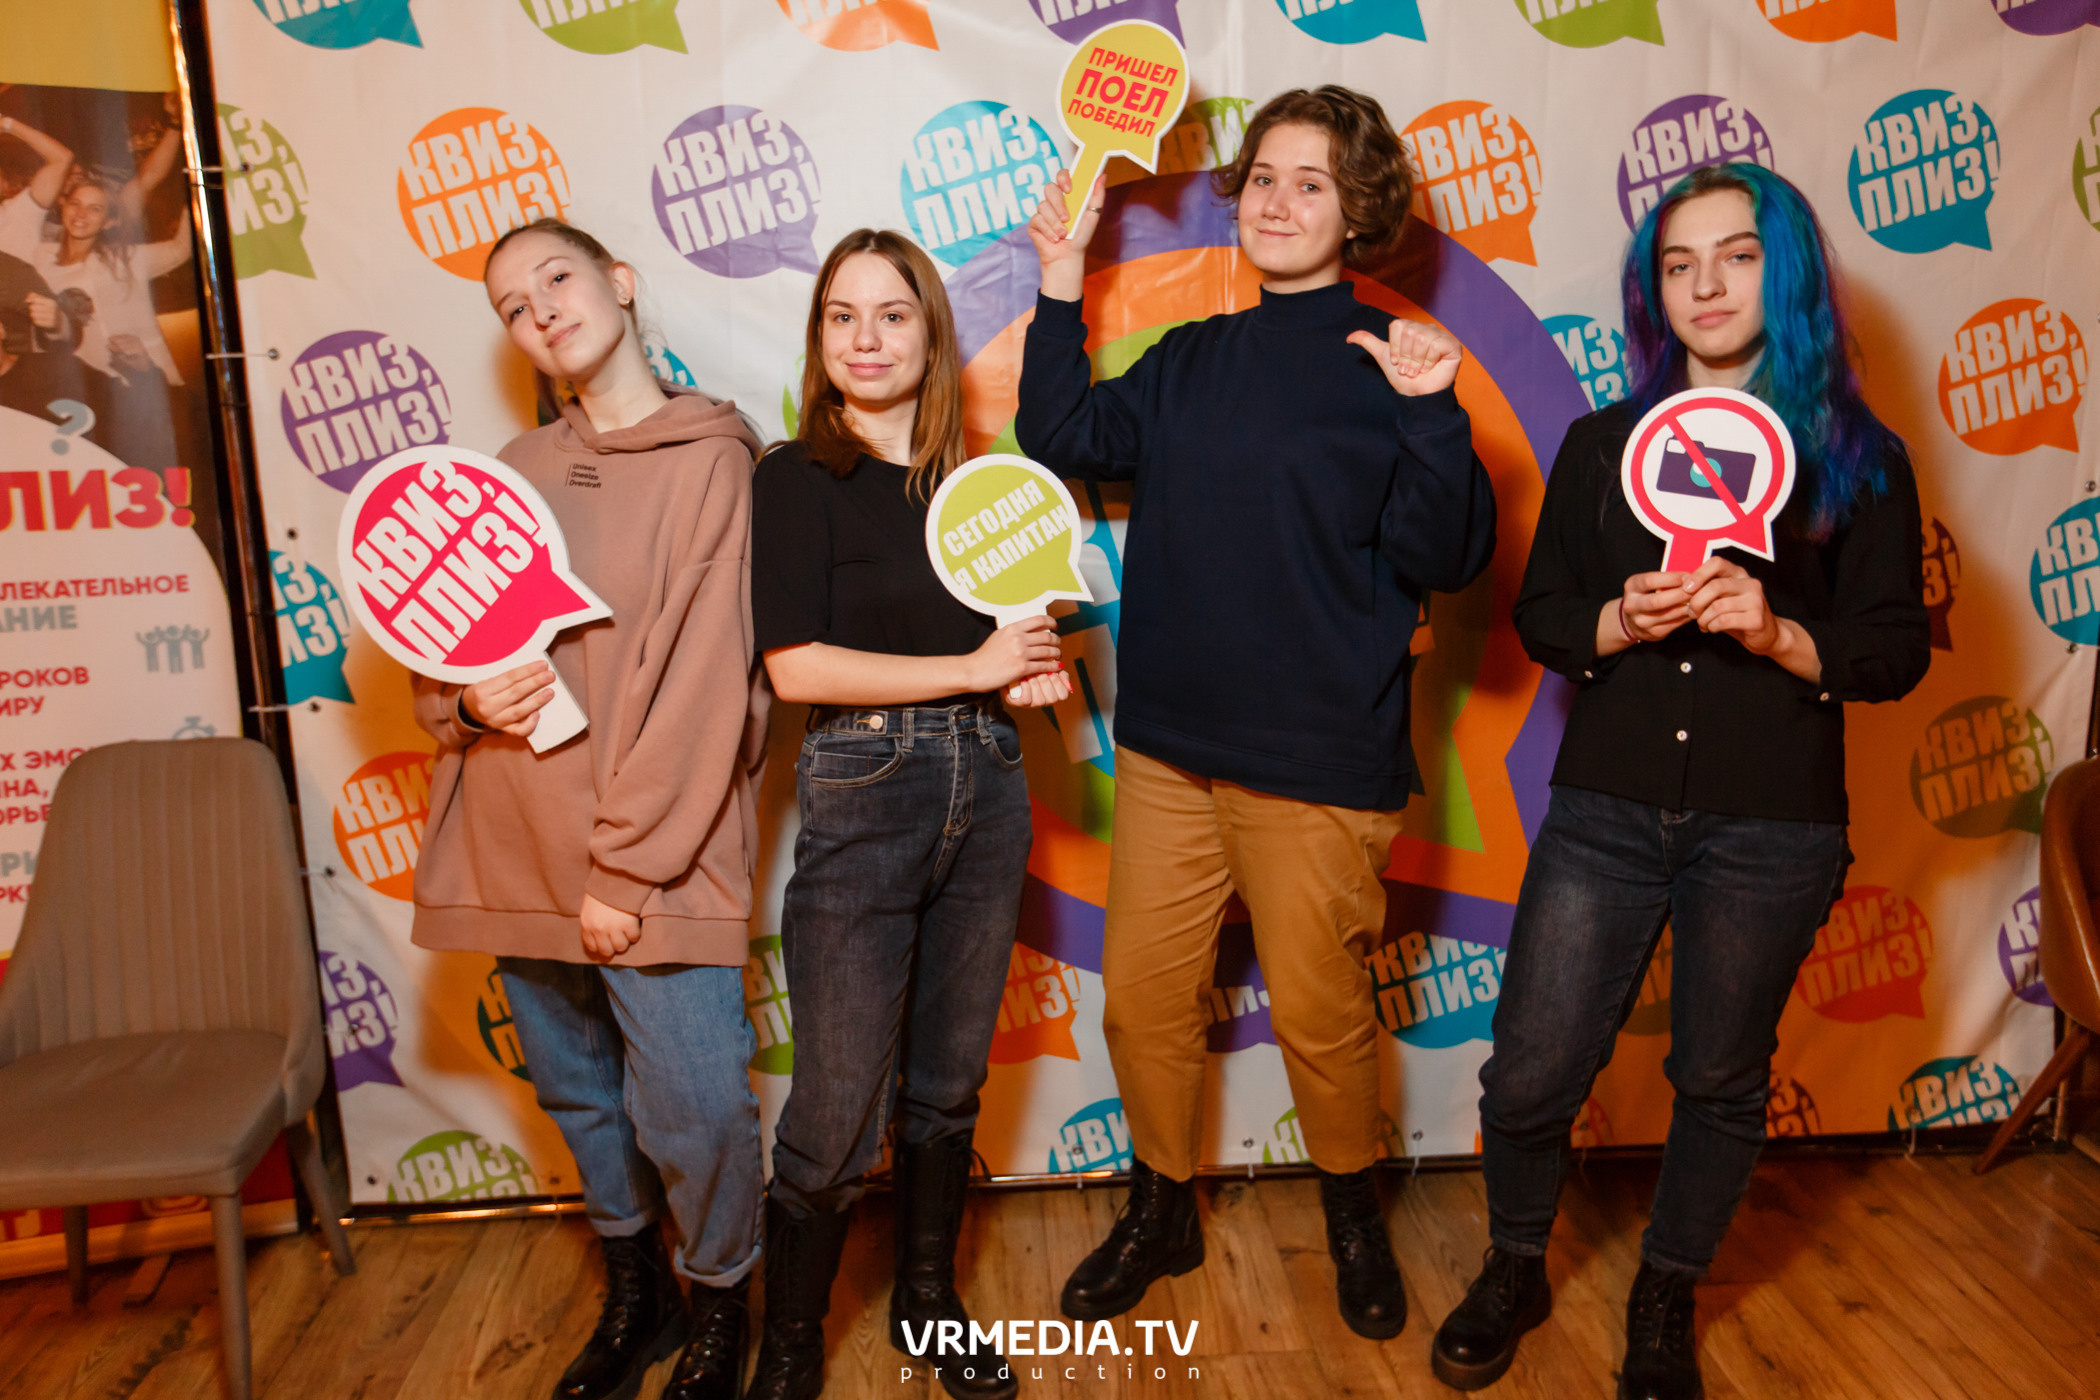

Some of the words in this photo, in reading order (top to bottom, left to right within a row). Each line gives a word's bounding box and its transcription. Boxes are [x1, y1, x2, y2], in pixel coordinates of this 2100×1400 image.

[1076, 68, 1169, 118] ПОЕЛ
[1088, 47, 1179, 87] ПРИШЕЛ
[402, 113, 552, 200] КВИЗ,
[656, 110, 804, 197] КВИЗ,
[904, 107, 1052, 192] КВИЗ,
[1067, 98, 1156, 138] ПОБЕДИЛ
[1624, 100, 1763, 184] КВИЗ,
[1856, 94, 1991, 176] КВИЗ,
[412, 165, 571, 260] ПЛИЗ!
[664, 160, 822, 256] ПЛИЗ!
[1412, 161, 1542, 235] ЛИЗ!
[1858, 140, 2000, 233] ПЛИЗ!
[284, 336, 433, 420] КВИЗ,
[1946, 302, 2078, 384] КВИЗ,
[295, 386, 451, 476] ПЛИЗ!
[1948, 348, 2087, 437] ПЛИЗ!
[569, 479, 602, 489] Overdraft
[571, 471, 599, 481] Onesize
[572, 463, 597, 472] Unisex
[355, 459, 495, 611] КВИЗ,
[942, 478, 1046, 557] СЕГОДНЯ
[953, 566, 978, 594] Я
[970, 503, 1073, 584] КАПИТАН
[390, 490, 547, 664] ПЛИЗ!
[0, 605, 78, 633] НИЕ
[1918, 702, 2048, 774] КВИЗ,
[1920, 740, 2053, 822] ПЛИЗ!
[1802, 928, 1933, 1007] ПЛИЗ!
[390, 1137, 524, 1202] КВИЗ,
